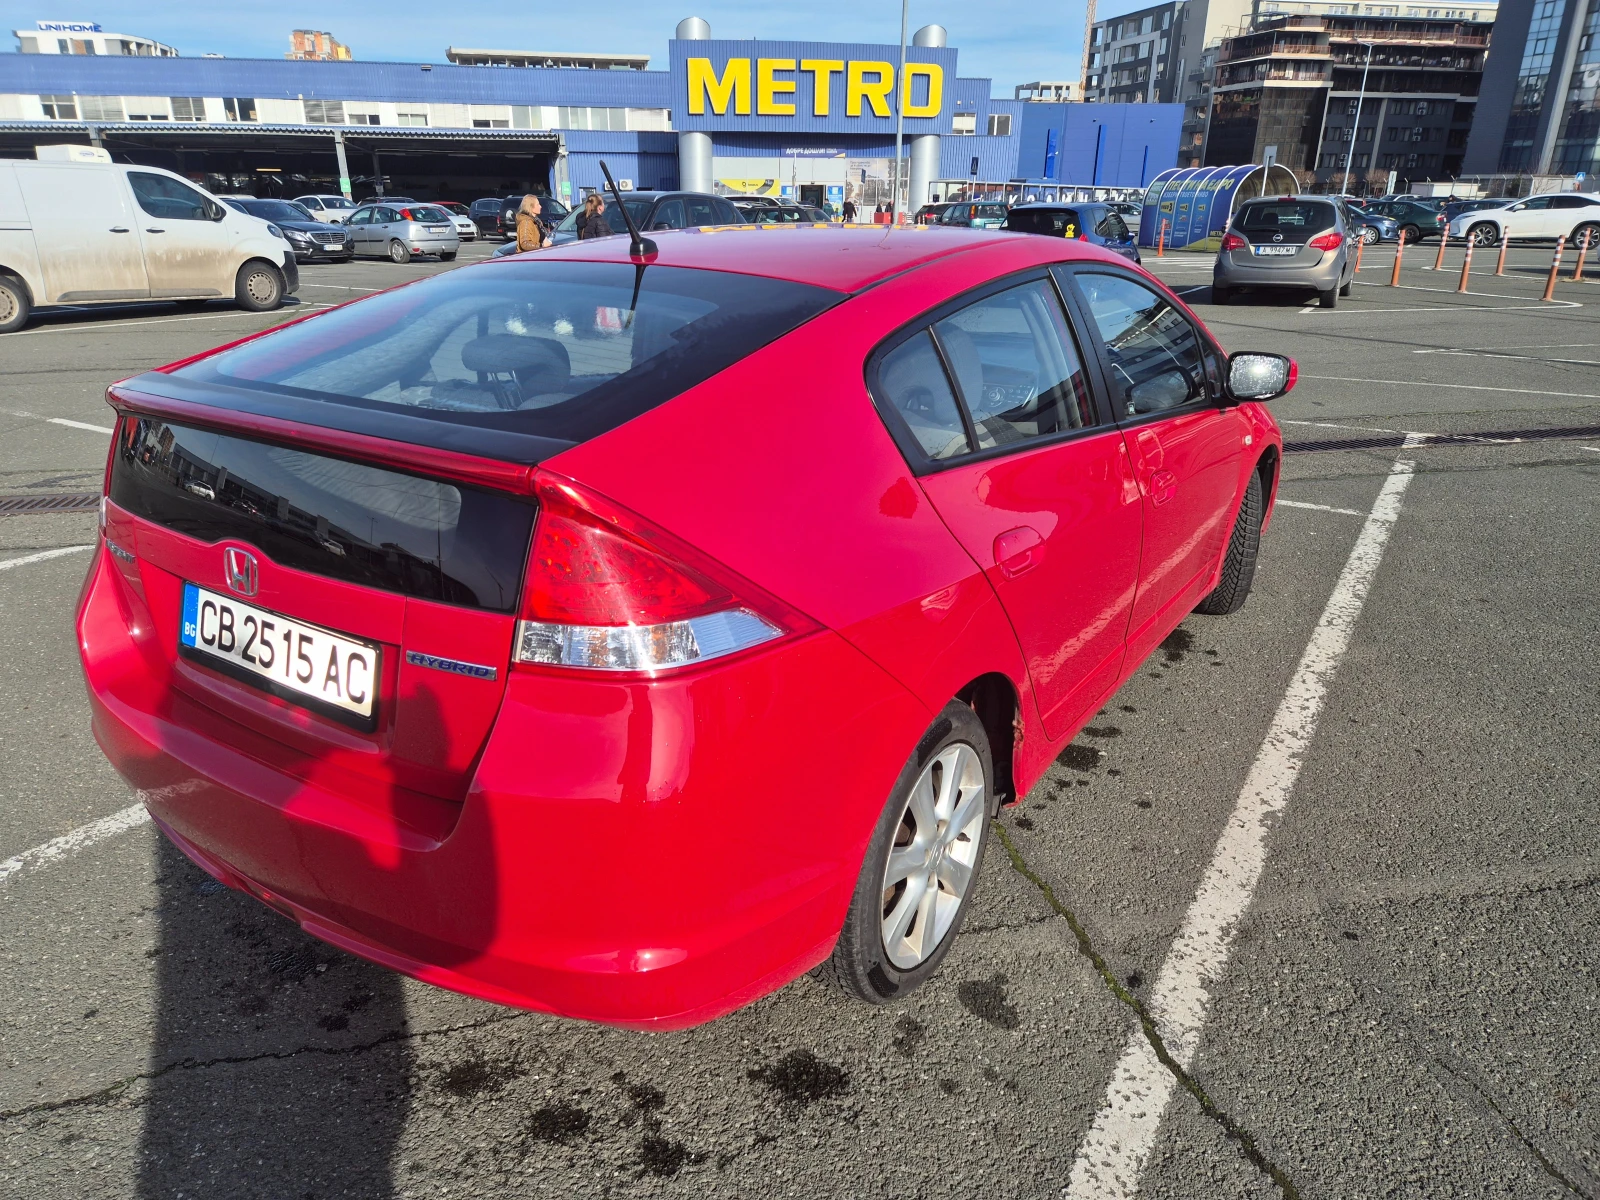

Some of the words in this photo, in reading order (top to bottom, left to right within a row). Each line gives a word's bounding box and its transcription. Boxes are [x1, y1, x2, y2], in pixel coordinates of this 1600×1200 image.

[38, 23, 103, 33] UNIHOME
[687, 57, 943, 118] METRO
[184, 621, 196, 638] BG
[200, 600, 236, 653] CB
[241, 615, 313, 684] 2515
[323, 644, 368, 704] AC
[410, 653, 489, 677] HYBRID
